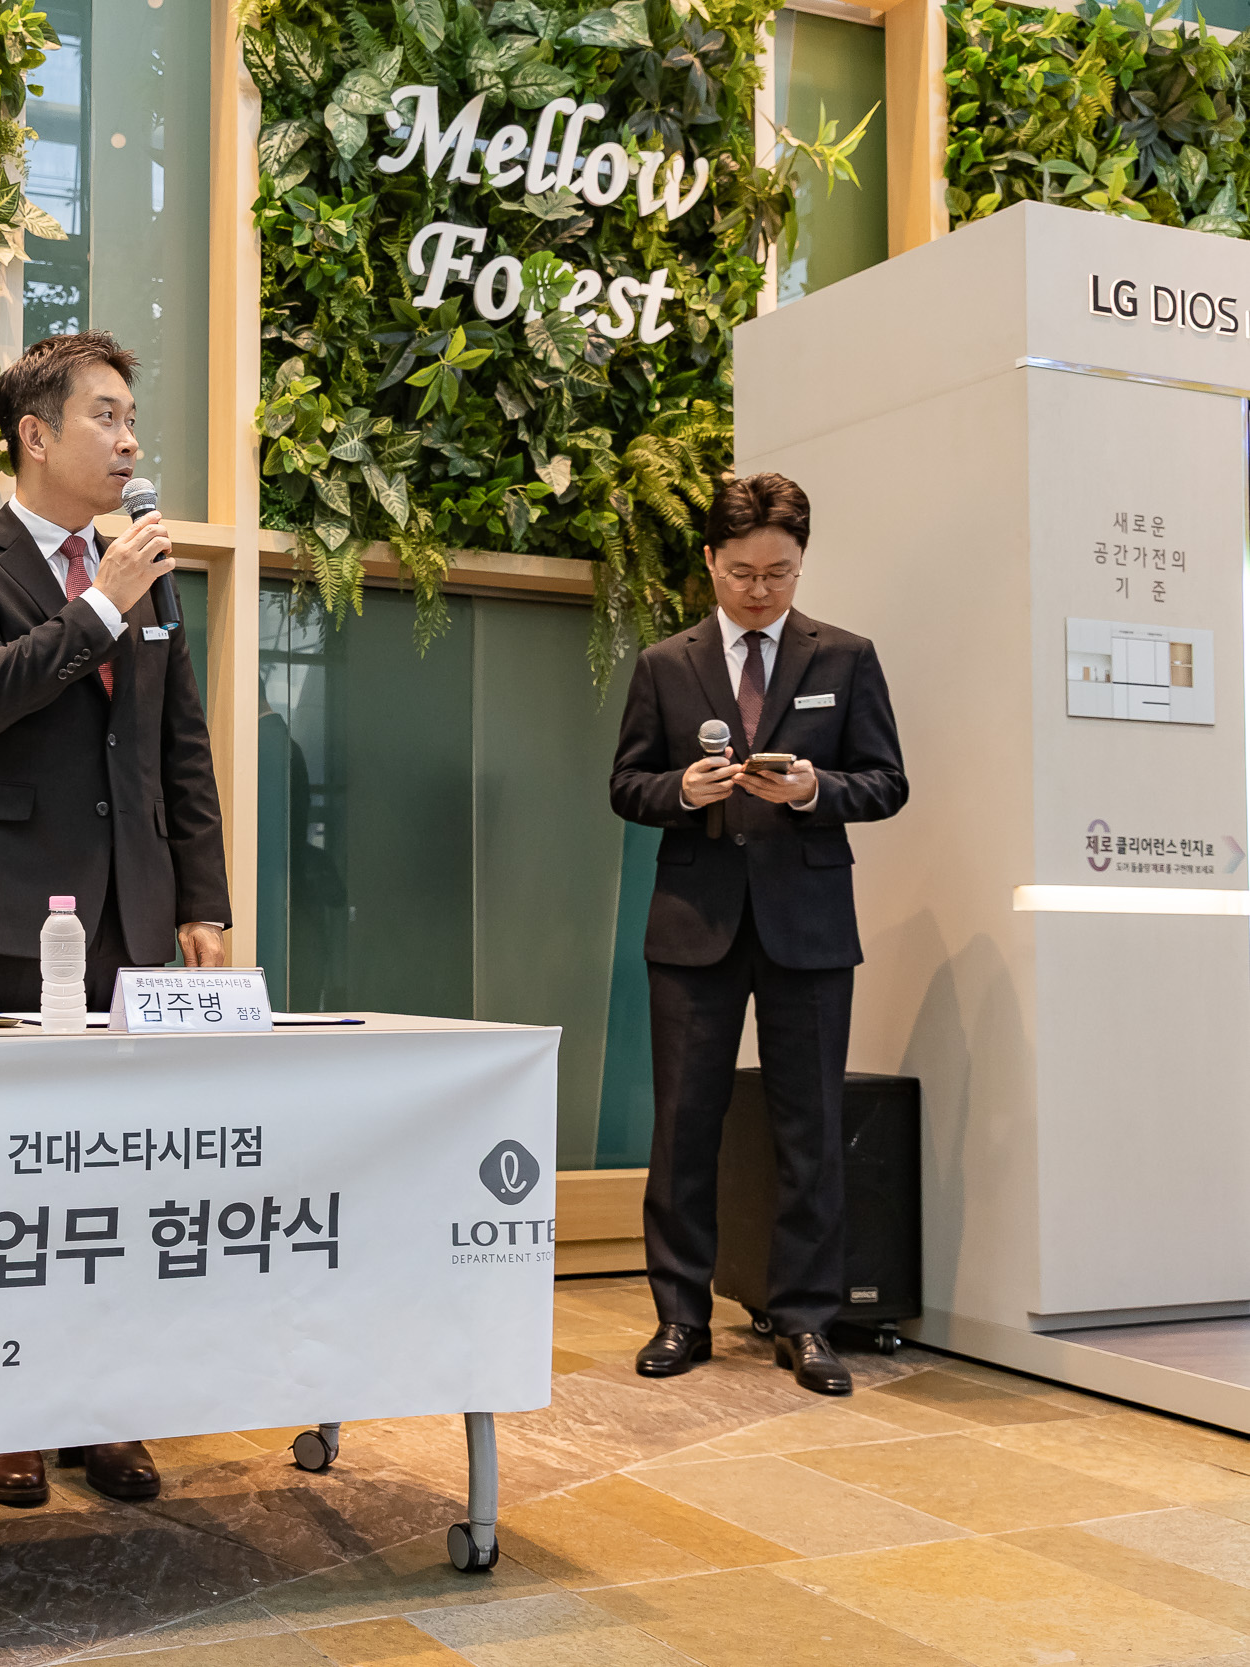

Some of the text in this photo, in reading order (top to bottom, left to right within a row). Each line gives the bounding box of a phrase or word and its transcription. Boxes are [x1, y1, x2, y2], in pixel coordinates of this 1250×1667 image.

[377, 84, 710, 222] Mellow
[1089, 273, 1138, 320] LG
[1151, 284, 1239, 336] DIOS
[1113, 512, 1165, 538] 새로운
[1093, 541, 1186, 573] 공간가전의
[1085, 836, 1215, 857] 제로 클리어런스 힌지로
[135, 977, 252, 988] 롯데백화점 건대스타시티점
[137, 991, 262, 1023] 김주병 점장
[7, 1125, 263, 1175] 건대스타시티점
[148, 1191, 341, 1280] 협약식
[451, 1252, 532, 1265] DEPARTMENT
